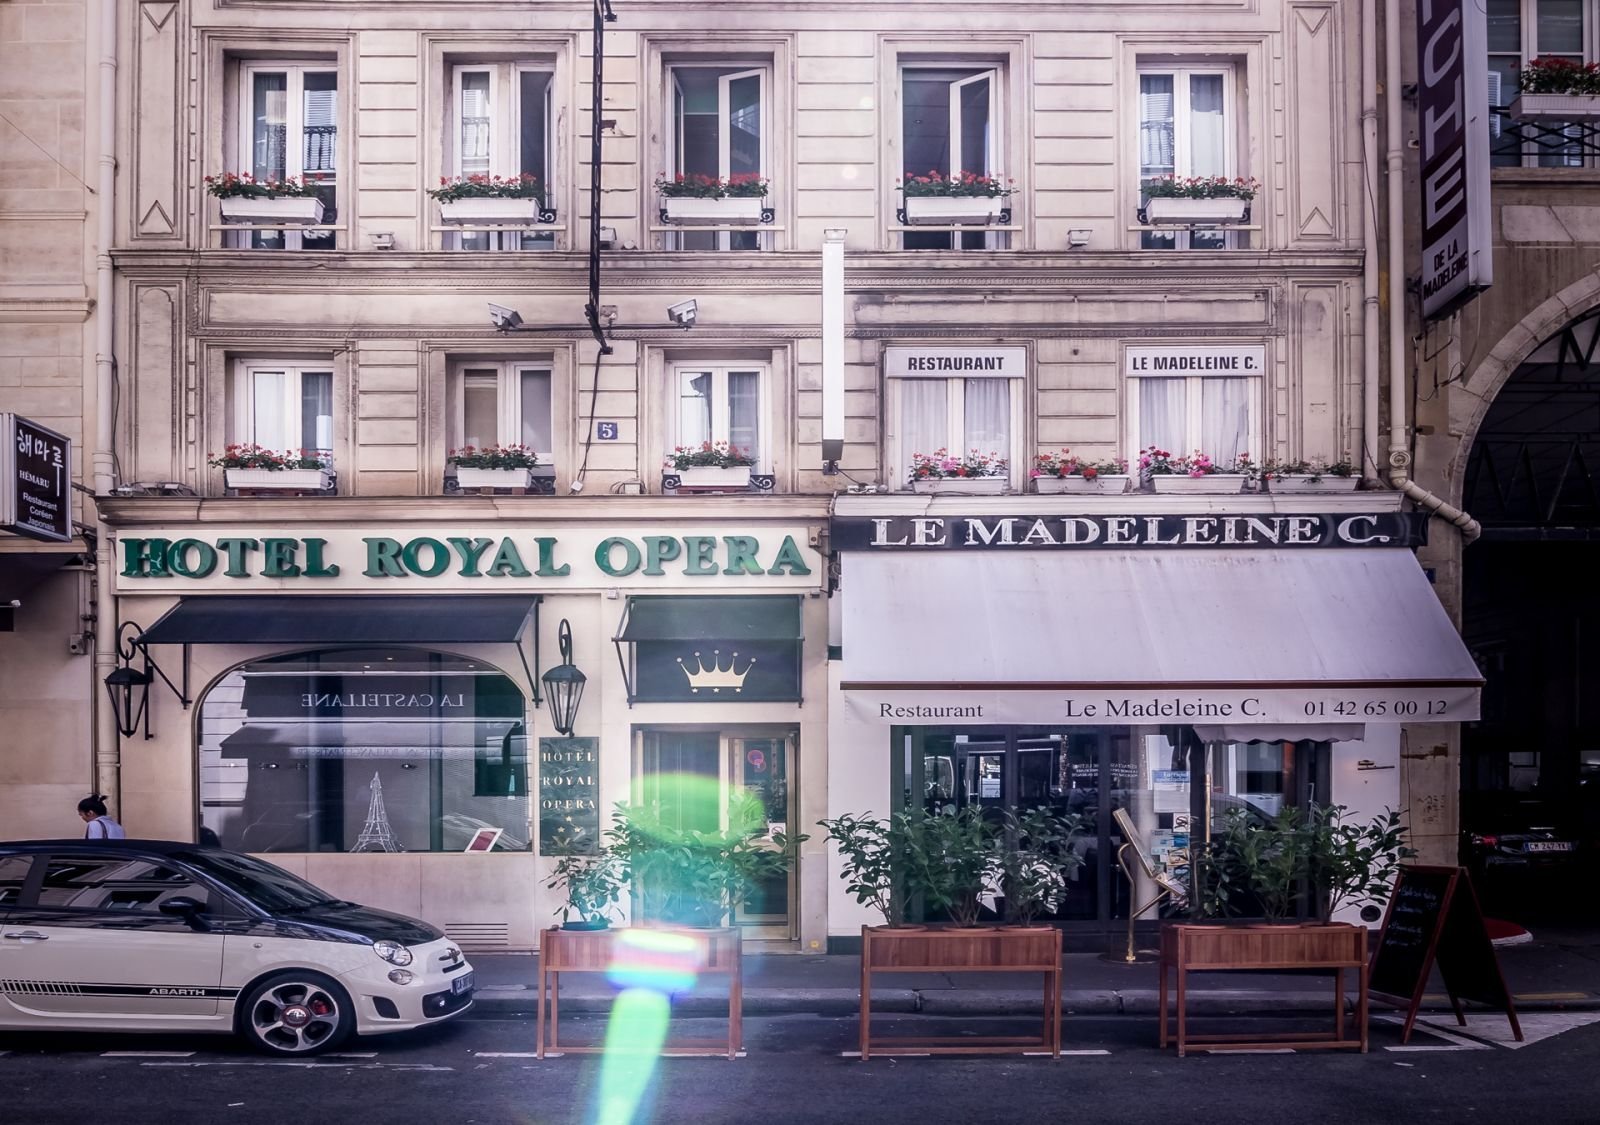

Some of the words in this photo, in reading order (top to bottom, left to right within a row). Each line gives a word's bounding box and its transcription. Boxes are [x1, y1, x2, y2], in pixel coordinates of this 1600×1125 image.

[1433, 248, 1446, 273] DE
[1447, 238, 1459, 261] LA
[1423, 250, 1468, 301] MADELEINE
[908, 356, 1004, 371] RESTAURANT
[1132, 356, 1148, 371] LE
[1153, 355, 1239, 370] MADELEINE
[1244, 355, 1259, 370] C.
[602, 423, 613, 439] 5
[19, 470, 50, 488] HÉMARU
[23, 492, 57, 511] Restaurant
[29, 506, 53, 519] Coréen
[28, 517, 55, 531] Japonais
[870, 518, 946, 546] LE
[963, 517, 1321, 545] MADELEINE
[1337, 515, 1390, 544] C.
[119, 537, 340, 579] HOTEL
[362, 536, 571, 578] ROYAL
[594, 534, 812, 577] OPERA
[879, 703, 984, 718] Restaurant
[1065, 699, 1097, 717] Le
[1104, 699, 1233, 717] Madeleine
[1240, 698, 1267, 716] C.
[1304, 701, 1325, 716] 01
[1333, 700, 1357, 716] 42
[1363, 700, 1387, 715] 65
[1394, 700, 1418, 715] 00
[1427, 700, 1448, 715] 12
[543, 752, 596, 762] HOTEL
[543, 776, 596, 786] ROYAL
[542, 799, 596, 809] OPERA
[149, 988, 206, 996] ABARTH
